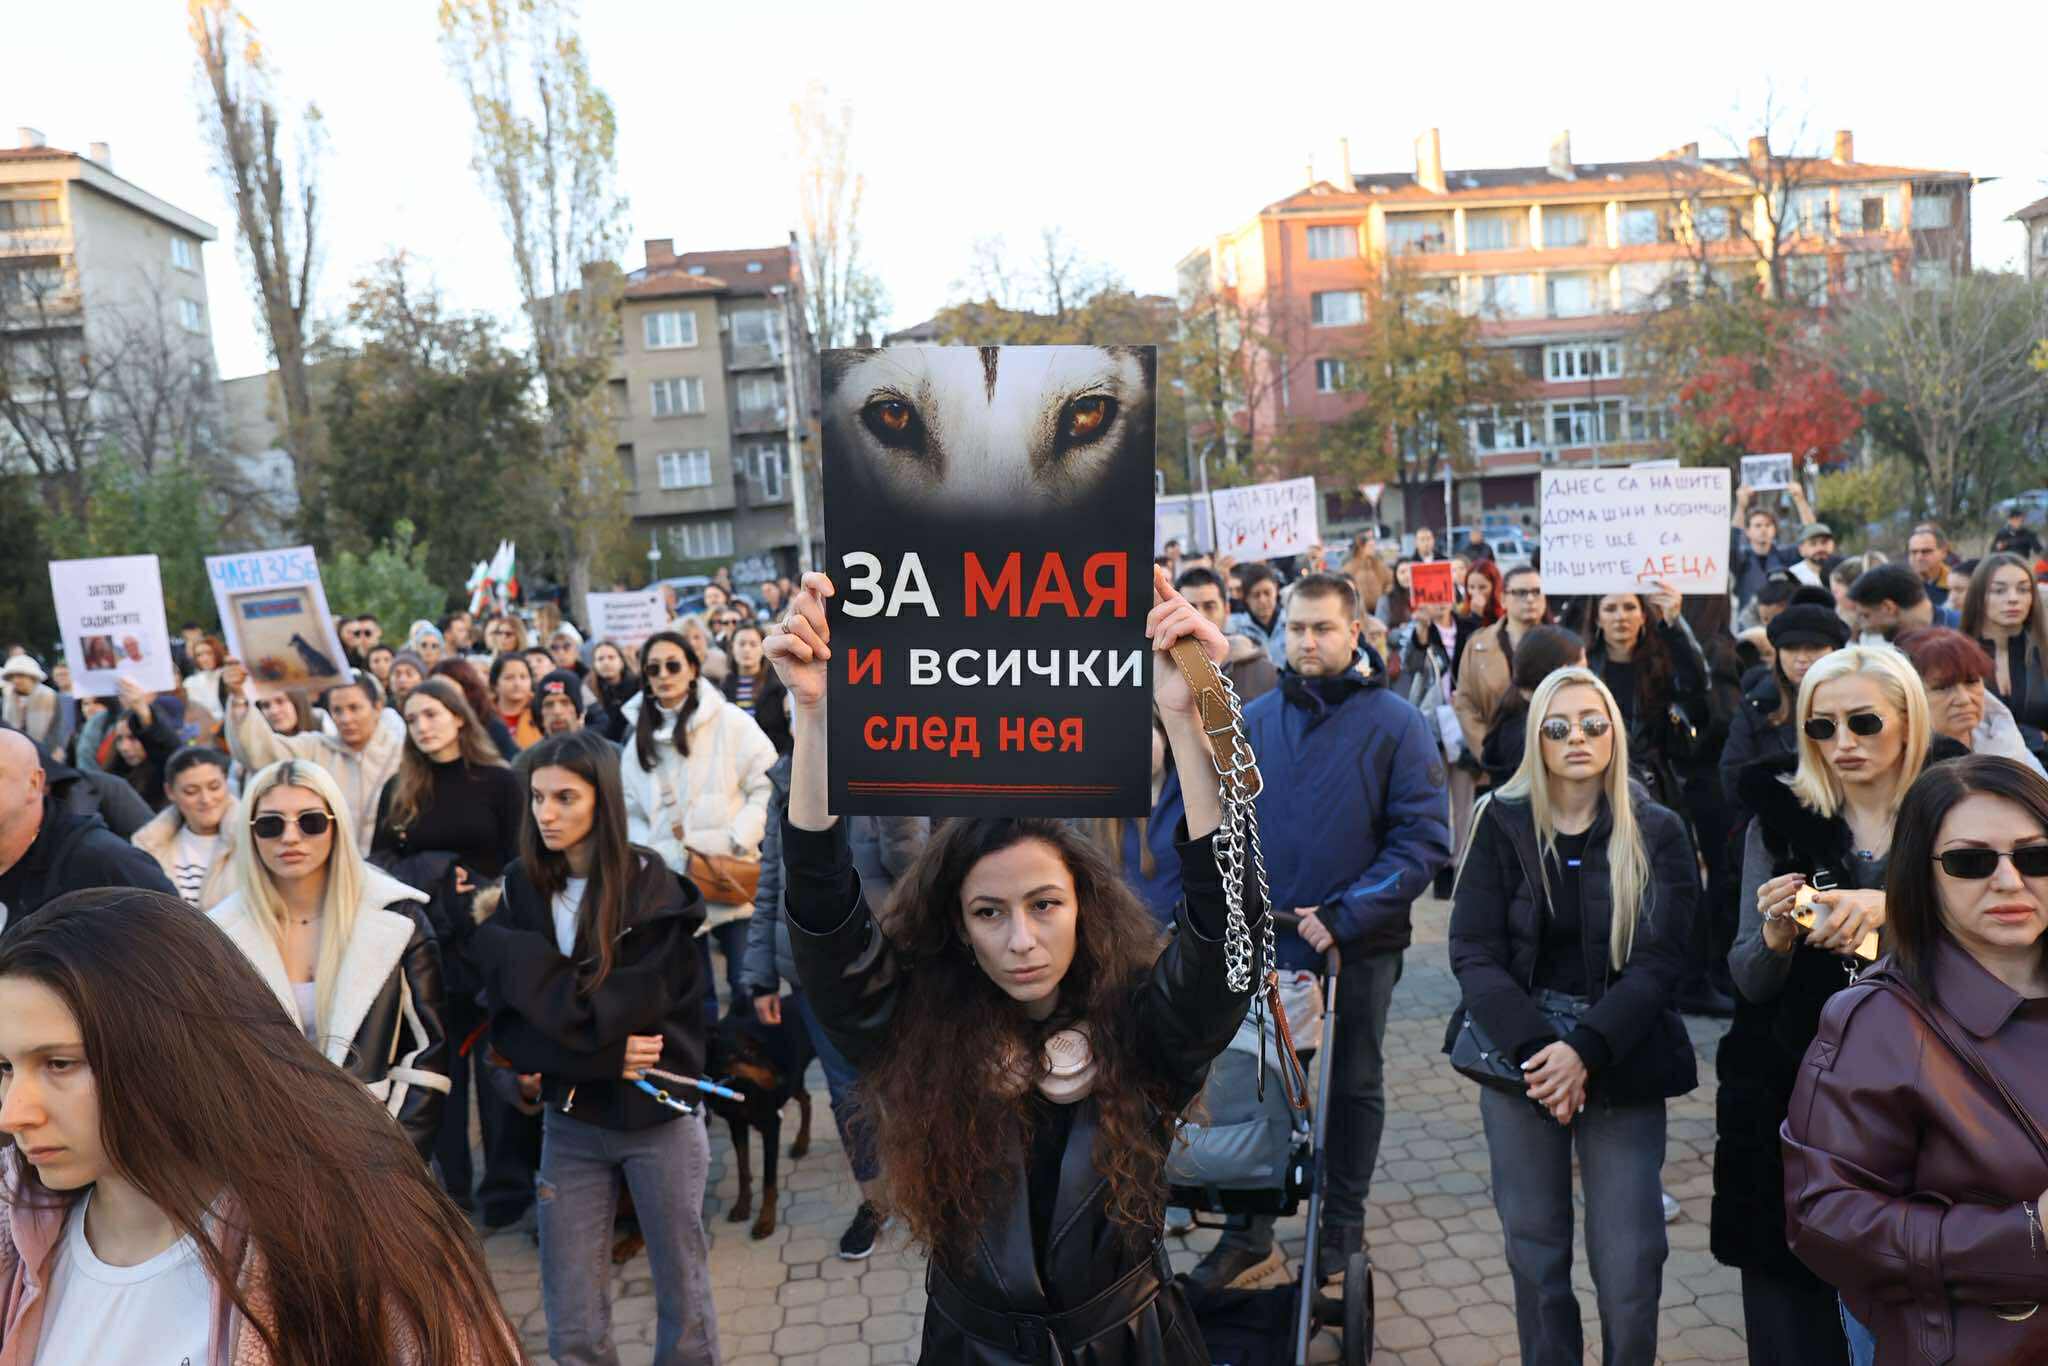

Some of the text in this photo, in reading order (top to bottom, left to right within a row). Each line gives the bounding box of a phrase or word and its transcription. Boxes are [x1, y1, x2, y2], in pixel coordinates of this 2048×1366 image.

[1544, 474, 1722, 499] ДНЕС СА НАШИТЕ
[1543, 504, 1645, 525] ДОМАШНИ
[1544, 533, 1595, 550] УТРЕ
[1660, 532, 1684, 545] СА
[1545, 554, 1718, 585] НАШИТЕ ДЕЦА
[841, 551, 940, 618] ЗА
[964, 551, 1128, 618] МАЯ
[863, 714, 1085, 758] след нея
